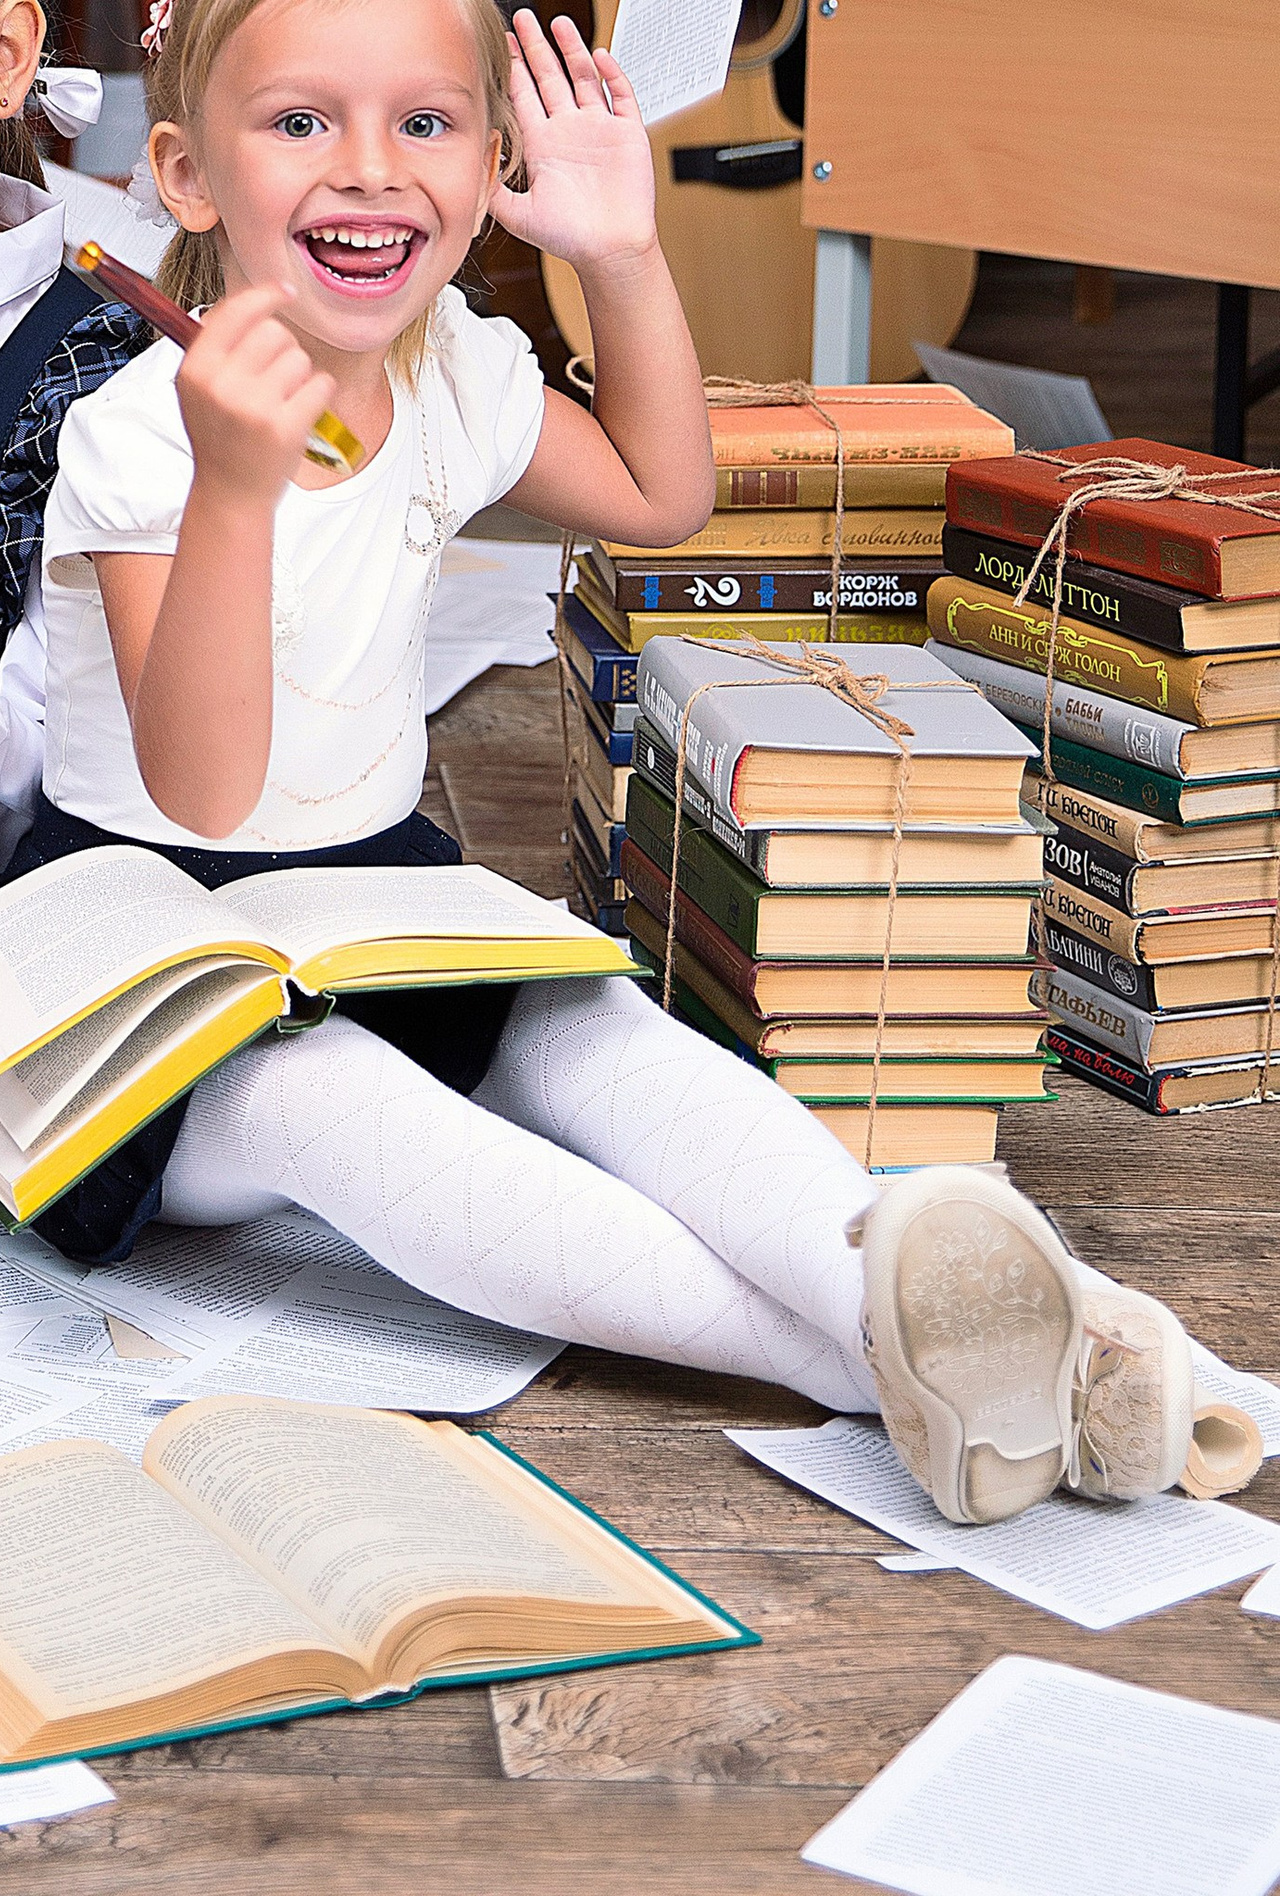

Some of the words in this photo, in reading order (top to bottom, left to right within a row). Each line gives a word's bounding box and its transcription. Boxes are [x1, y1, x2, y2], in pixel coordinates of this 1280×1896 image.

[771, 445, 962, 462] ЧИНИЗ-ХАН
[745, 518, 811, 547] Явка
[813, 591, 918, 607] БОРДОНОВ
[838, 575, 899, 590] КОРЖ
[975, 552, 1025, 588] ЛОРД
[1035, 573, 1120, 622] ЛИТТОН
[989, 624, 1019, 647] АНН
[1020, 634, 1034, 652] И
[1035, 640, 1072, 666] СЕРЖ
[1074, 651, 1121, 683] ГОЛОН
[985, 683, 1052, 712] БЕРЕЗОВСКИ
[1065, 698, 1104, 723] БАБЬИ
[1061, 794, 1118, 841] БРЕТОН
[1044, 836, 1082, 876] ЗОВ
[1058, 892, 1114, 942] БРЕТОН
[1031, 923, 1105, 976] БАТИНИ
[1031, 976, 1127, 1039] ТАФЬЕВ
